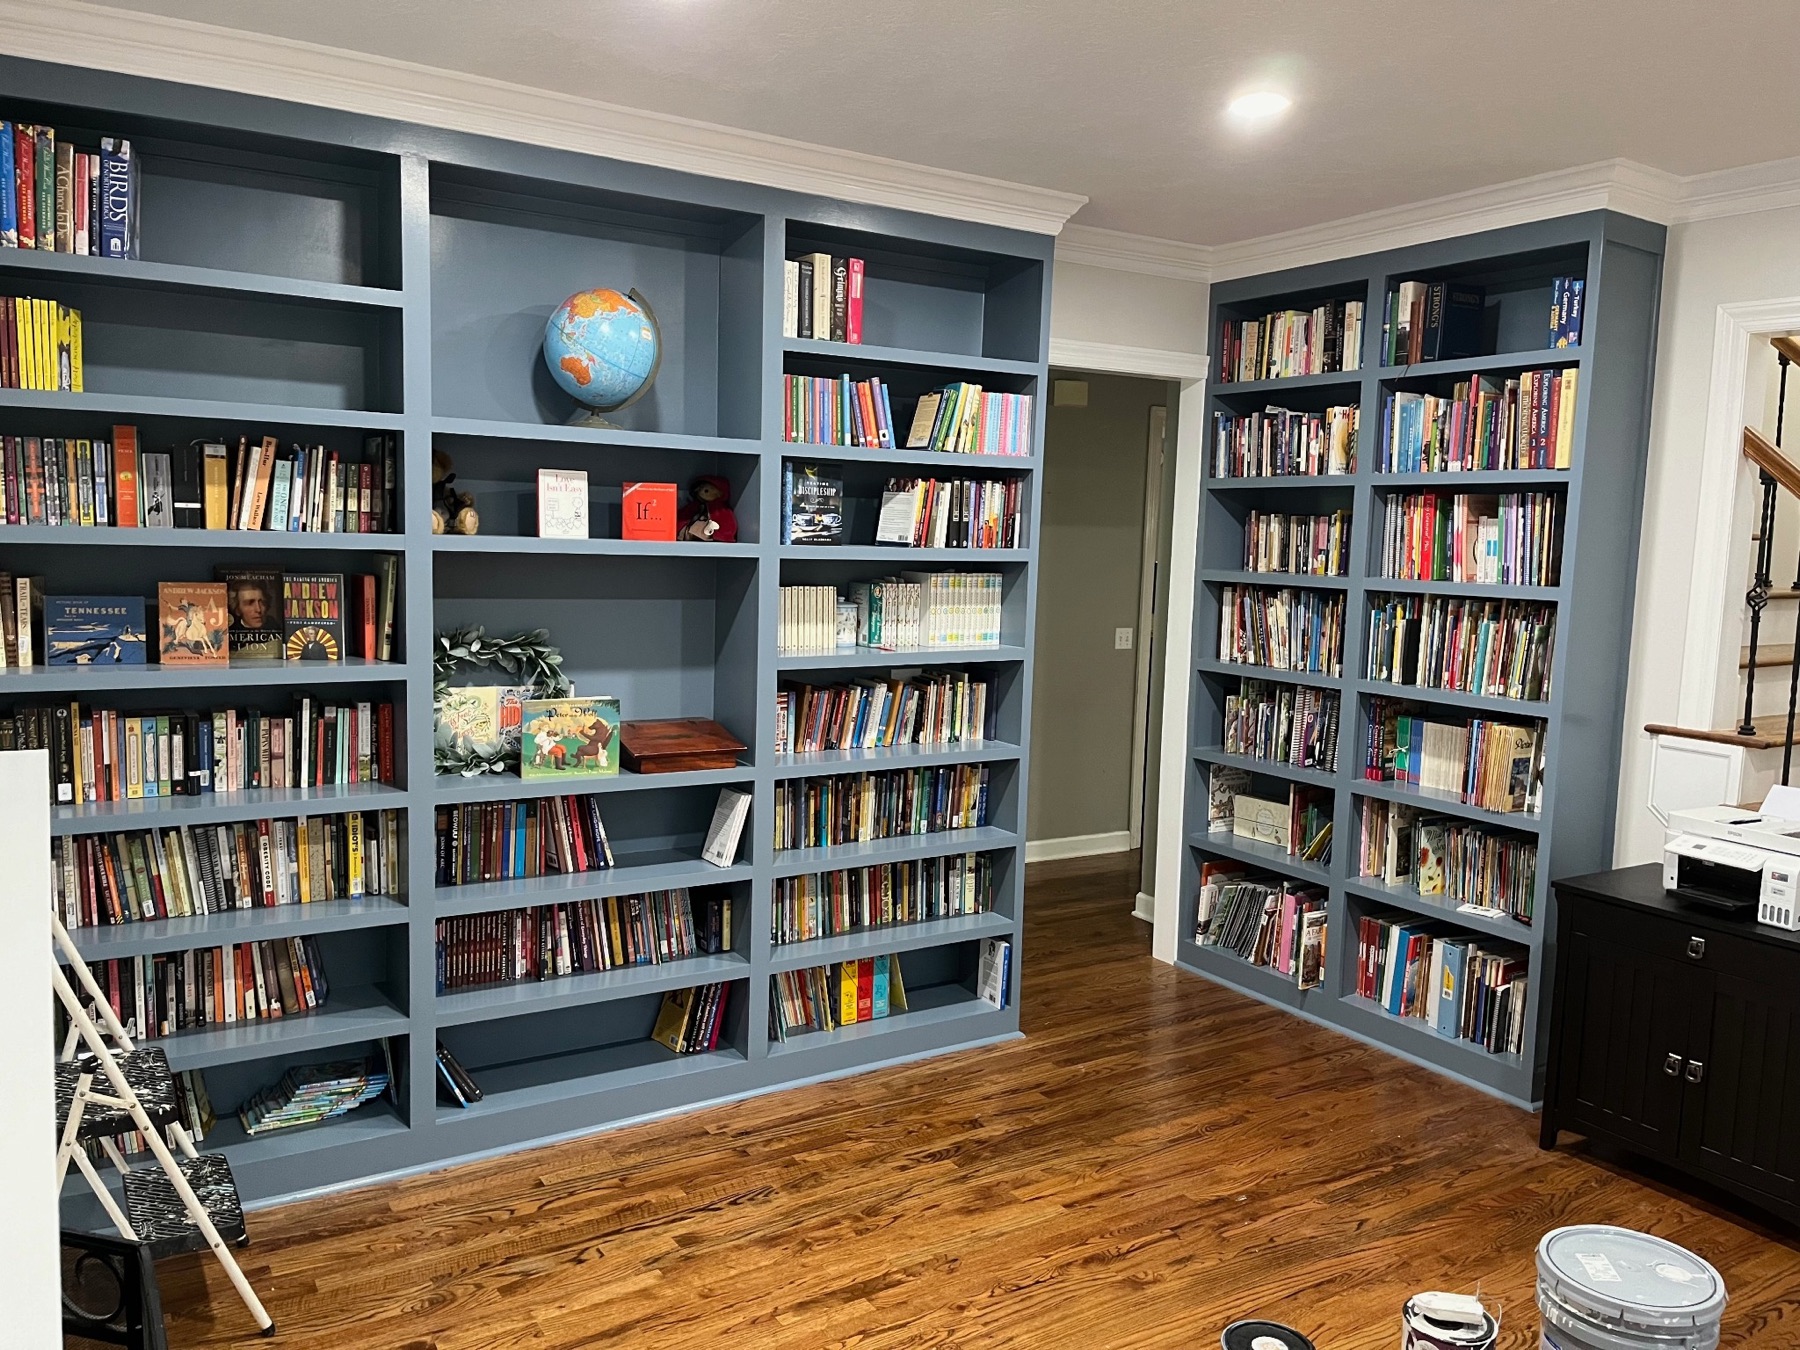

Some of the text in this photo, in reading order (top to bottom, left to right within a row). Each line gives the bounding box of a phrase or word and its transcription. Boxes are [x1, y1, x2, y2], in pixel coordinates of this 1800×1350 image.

[104, 160, 109, 168] OF
[58, 176, 69, 210] Chance
[110, 161, 128, 222] BIRDS
[57, 221, 69, 238] Die
[1431, 286, 1441, 328] STRONG'S
[1560, 292, 1570, 324] Germany
[1532, 374, 1541, 406] EXPLORING
[1542, 374, 1550, 406] EXPLORING
[1520, 396, 1530, 454] MEDIEVAL WORLD
[262, 440, 272, 466] Ben-Hur
[565, 484, 582, 495] Easy
[799, 487, 836, 496] DISCIPLESHIP
[252, 505, 260, 526] Wallace
[637, 502, 662, 520] If...
[284, 583, 337, 599] ANDREW
[206, 597, 219, 612] A
[285, 600, 338, 618] JACKSON
[210, 610, 224, 626] J
[229, 633, 282, 642] MERICAN
[546, 707, 597, 721] Peter Wolf
[62, 835, 72, 866] Atomic
[215, 877, 225, 905] PICTURES
